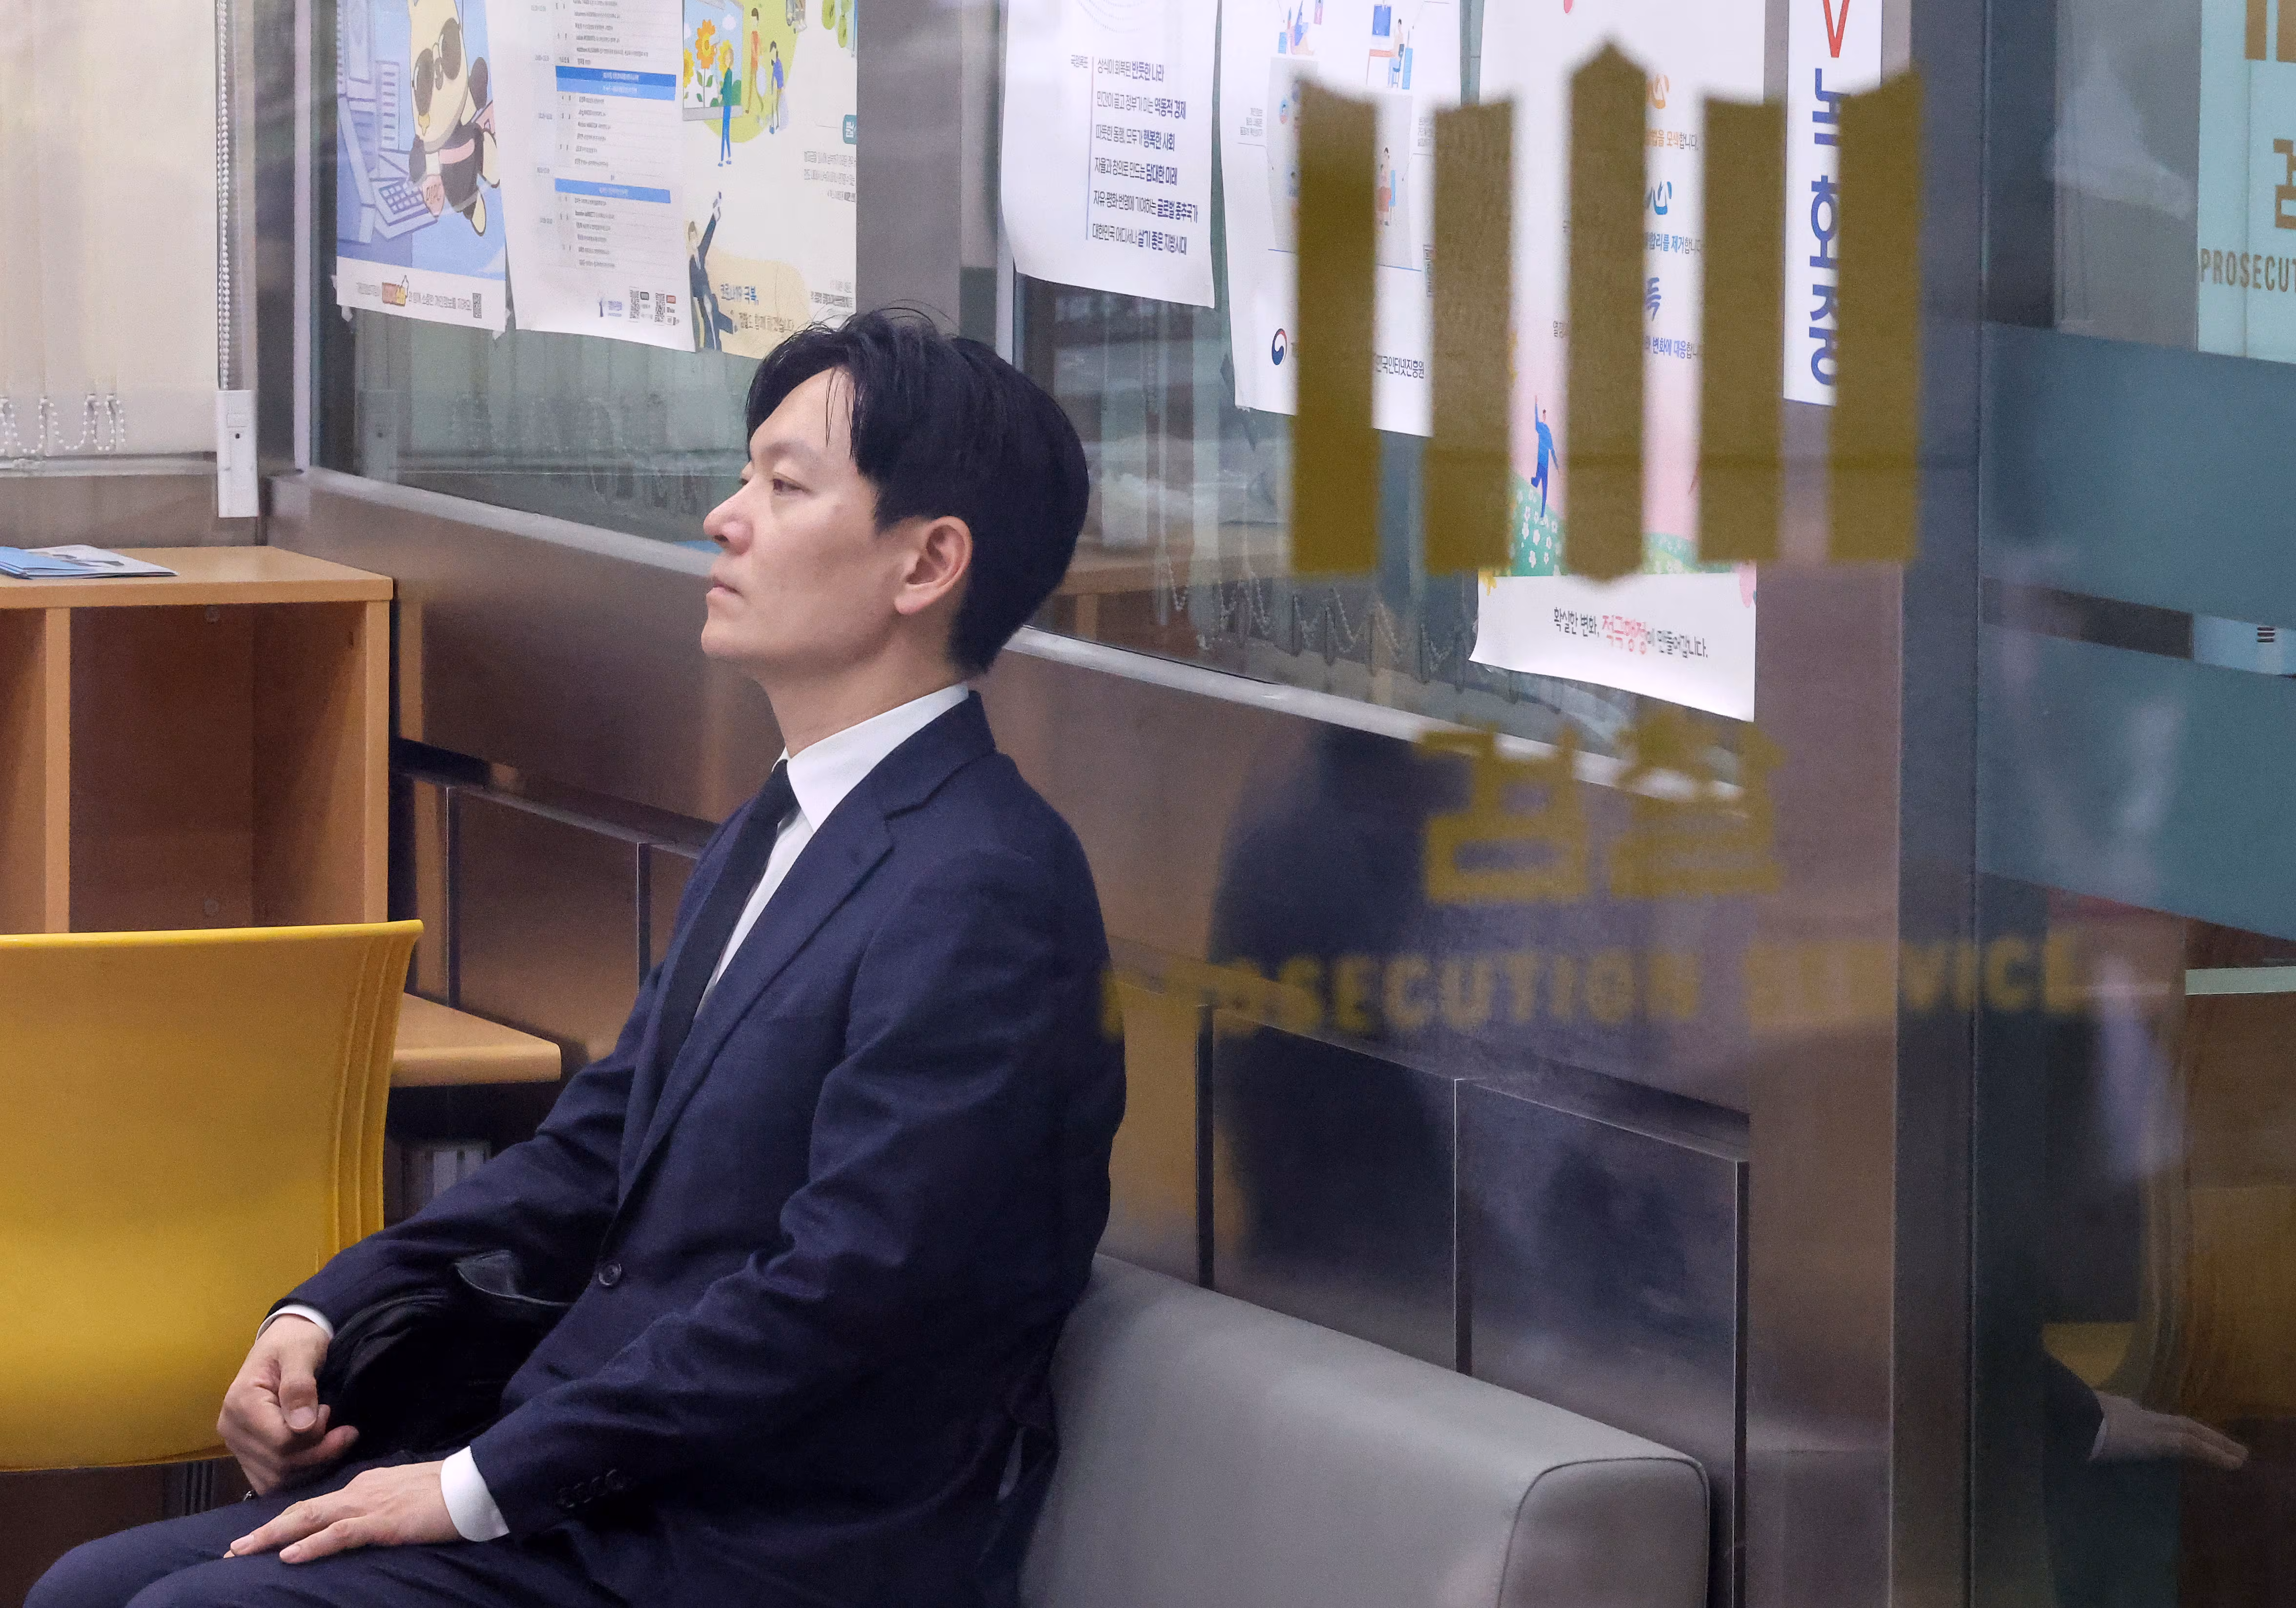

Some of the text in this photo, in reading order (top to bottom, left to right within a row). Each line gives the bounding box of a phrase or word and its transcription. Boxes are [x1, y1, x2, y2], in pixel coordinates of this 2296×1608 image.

[1098, 59, 1164, 82] 상식이 회복된 반듯한 나라
[1097, 91, 1186, 120] 민간이 끌고 정부가 미는 역동적 경제
[1096, 124, 1112, 141] 따뜻한
[1127, 128, 1142, 145] 모두가
[1144, 129, 1161, 150] 행복한
[1163, 132, 1175, 151] 사회
[1095, 157, 1177, 186] 자율과 창의로 만드는 담대한 미래
[1135, 196, 1156, 215] 기여하는
[1158, 199, 1174, 219] 글로벌
[1175, 201, 1198, 223] 중추국가
[1092, 223, 1115, 241] 대한민국
[1116, 227, 1137, 244] 어디서나
[1138, 229, 1150, 248] 살기
[1152, 231, 1163, 251] 좋은
[2200, 248, 2296, 294] PROSECU
[1554, 607, 1578, 635] 확실한
